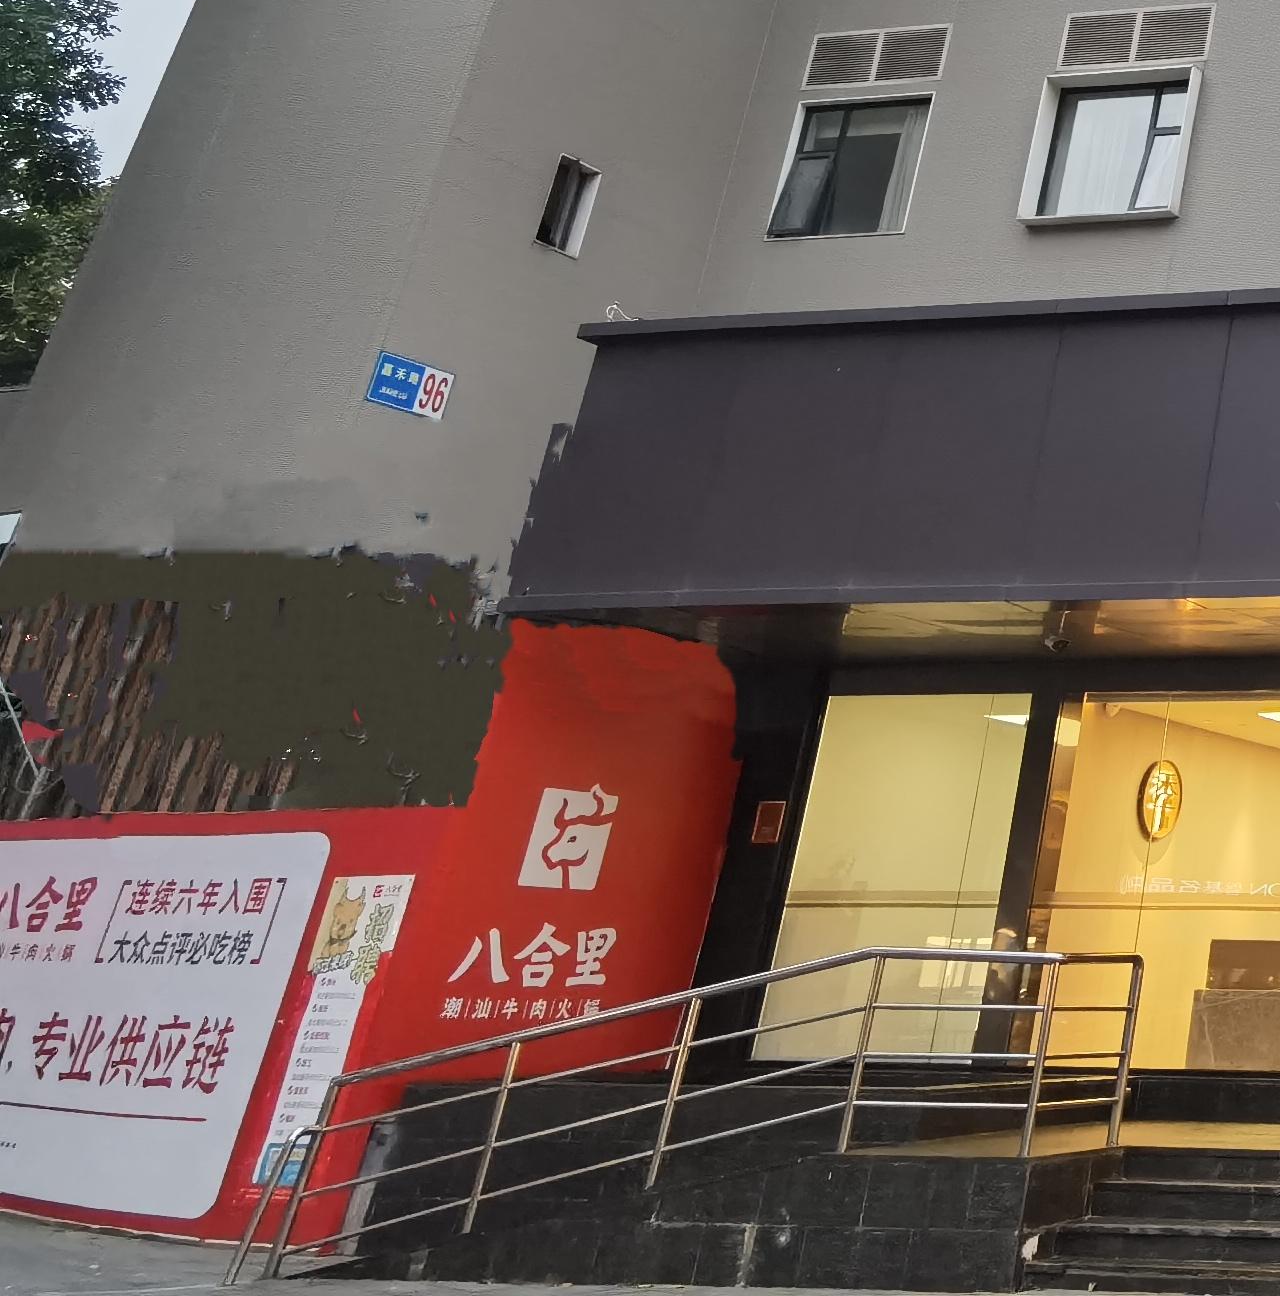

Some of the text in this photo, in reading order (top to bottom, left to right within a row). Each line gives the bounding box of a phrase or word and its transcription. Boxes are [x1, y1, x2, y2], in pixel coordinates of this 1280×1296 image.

[418, 373, 449, 413] 96
[124, 877, 273, 916] 连续六年入围
[107, 930, 254, 966] 大众点评必吃榜
[447, 922, 618, 988] 八合里
